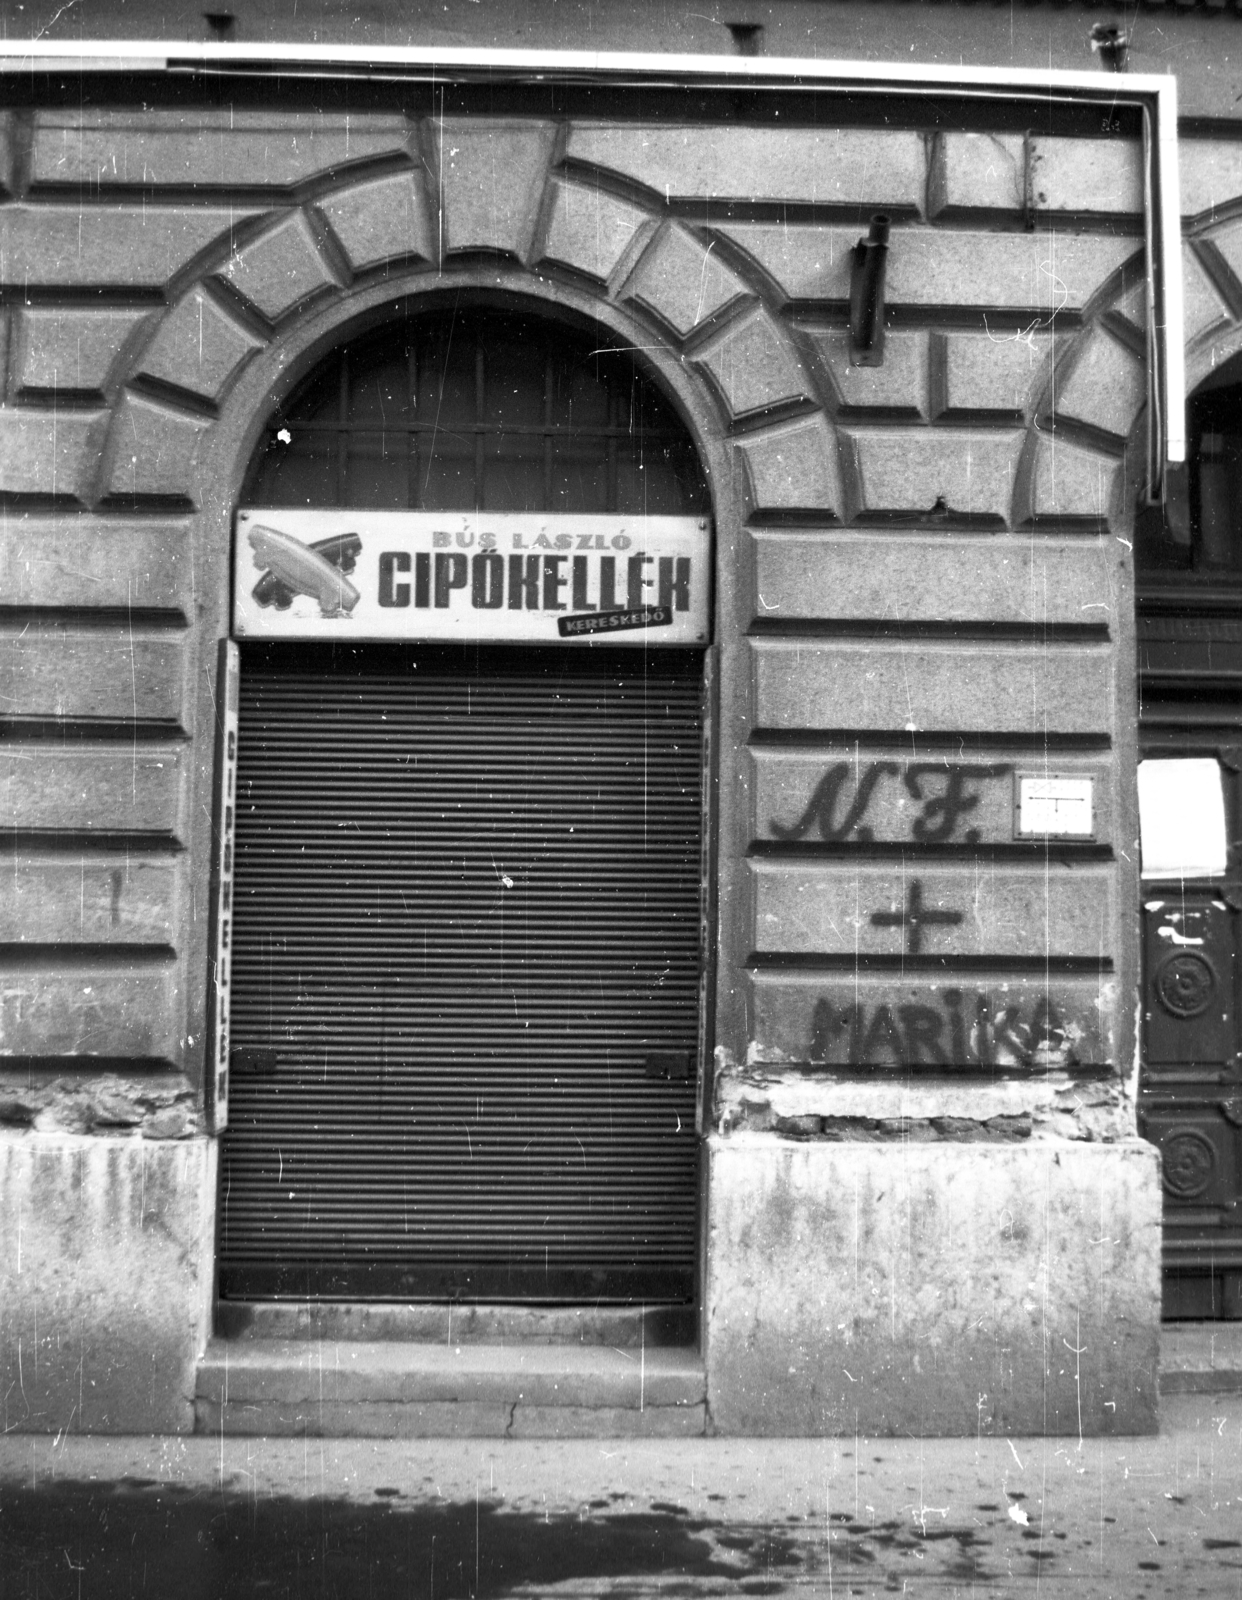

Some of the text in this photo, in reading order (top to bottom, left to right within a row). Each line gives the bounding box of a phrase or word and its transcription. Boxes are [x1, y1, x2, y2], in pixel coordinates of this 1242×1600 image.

[433, 525, 632, 551] BÚS LÁSZLÓ
[377, 548, 691, 612] CIPŐKELLÉK
[565, 607, 666, 632] KERESKEDŐ
